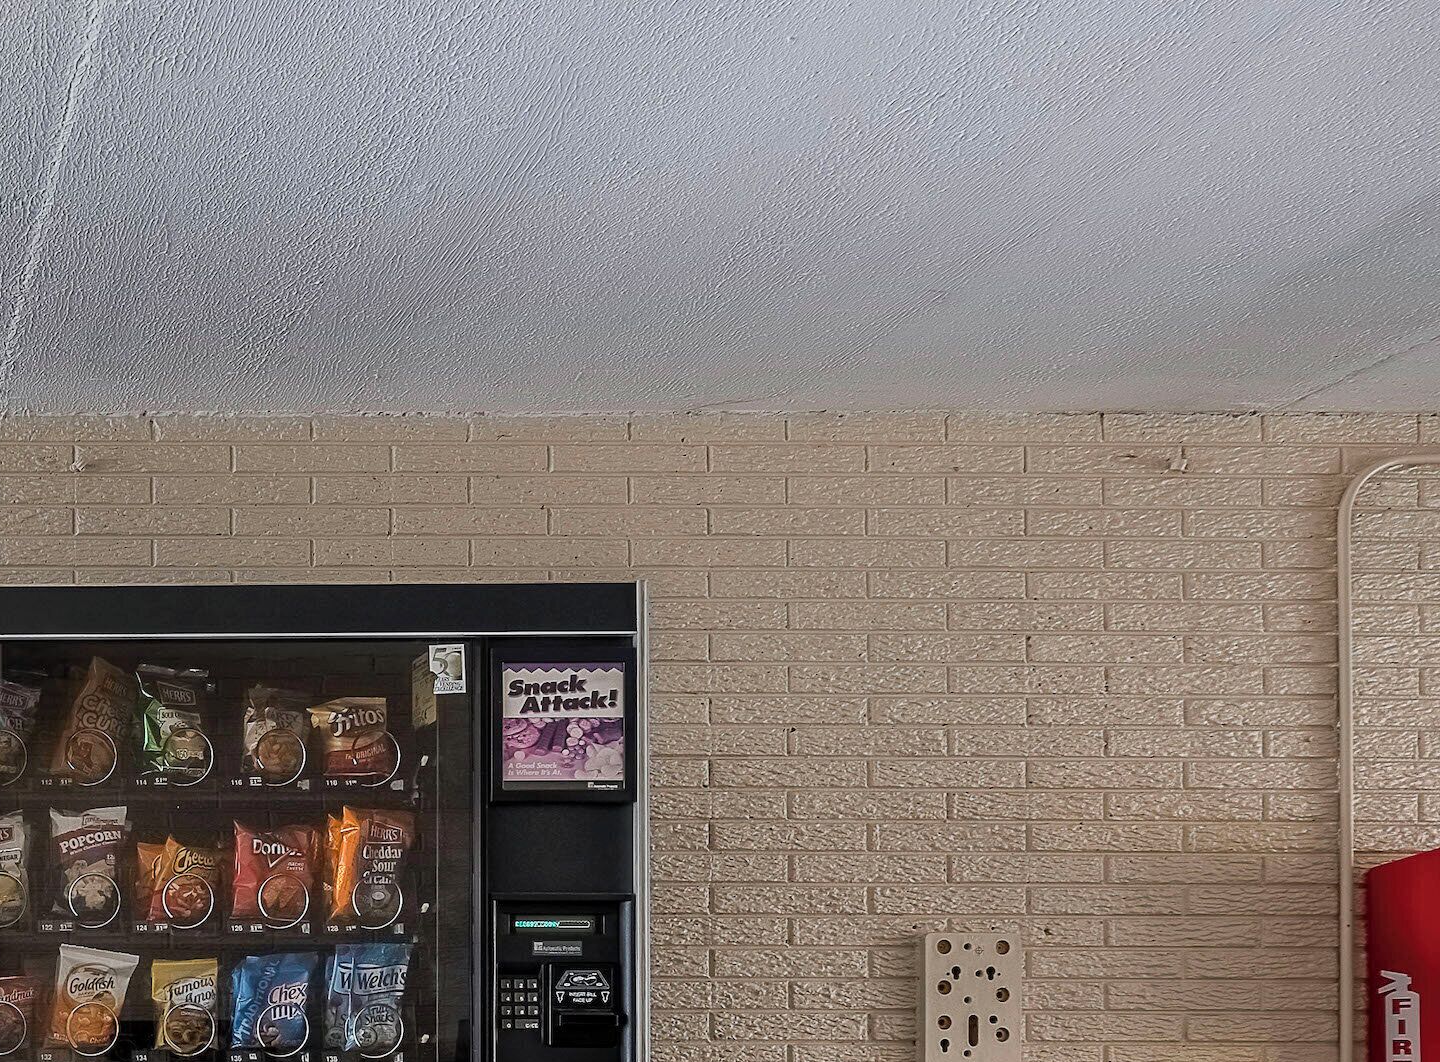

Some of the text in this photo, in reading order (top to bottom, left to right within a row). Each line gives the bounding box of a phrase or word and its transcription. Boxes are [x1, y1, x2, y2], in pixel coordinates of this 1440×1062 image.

[508, 675, 587, 697] Snack
[520, 690, 618, 713] Attack!
[59, 830, 122, 854] POPCORN
[370, 826, 399, 841] HERR'S
[362, 845, 404, 860] Cheddar
[371, 860, 397, 874] Sour
[69, 976, 116, 994] Goldfish
[164, 977, 215, 1001] Famous
[357, 969, 408, 990] Welch's
[185, 989, 216, 1004] Amos
[269, 982, 307, 1002] Chex
[136, 1054, 147, 1062] 134
